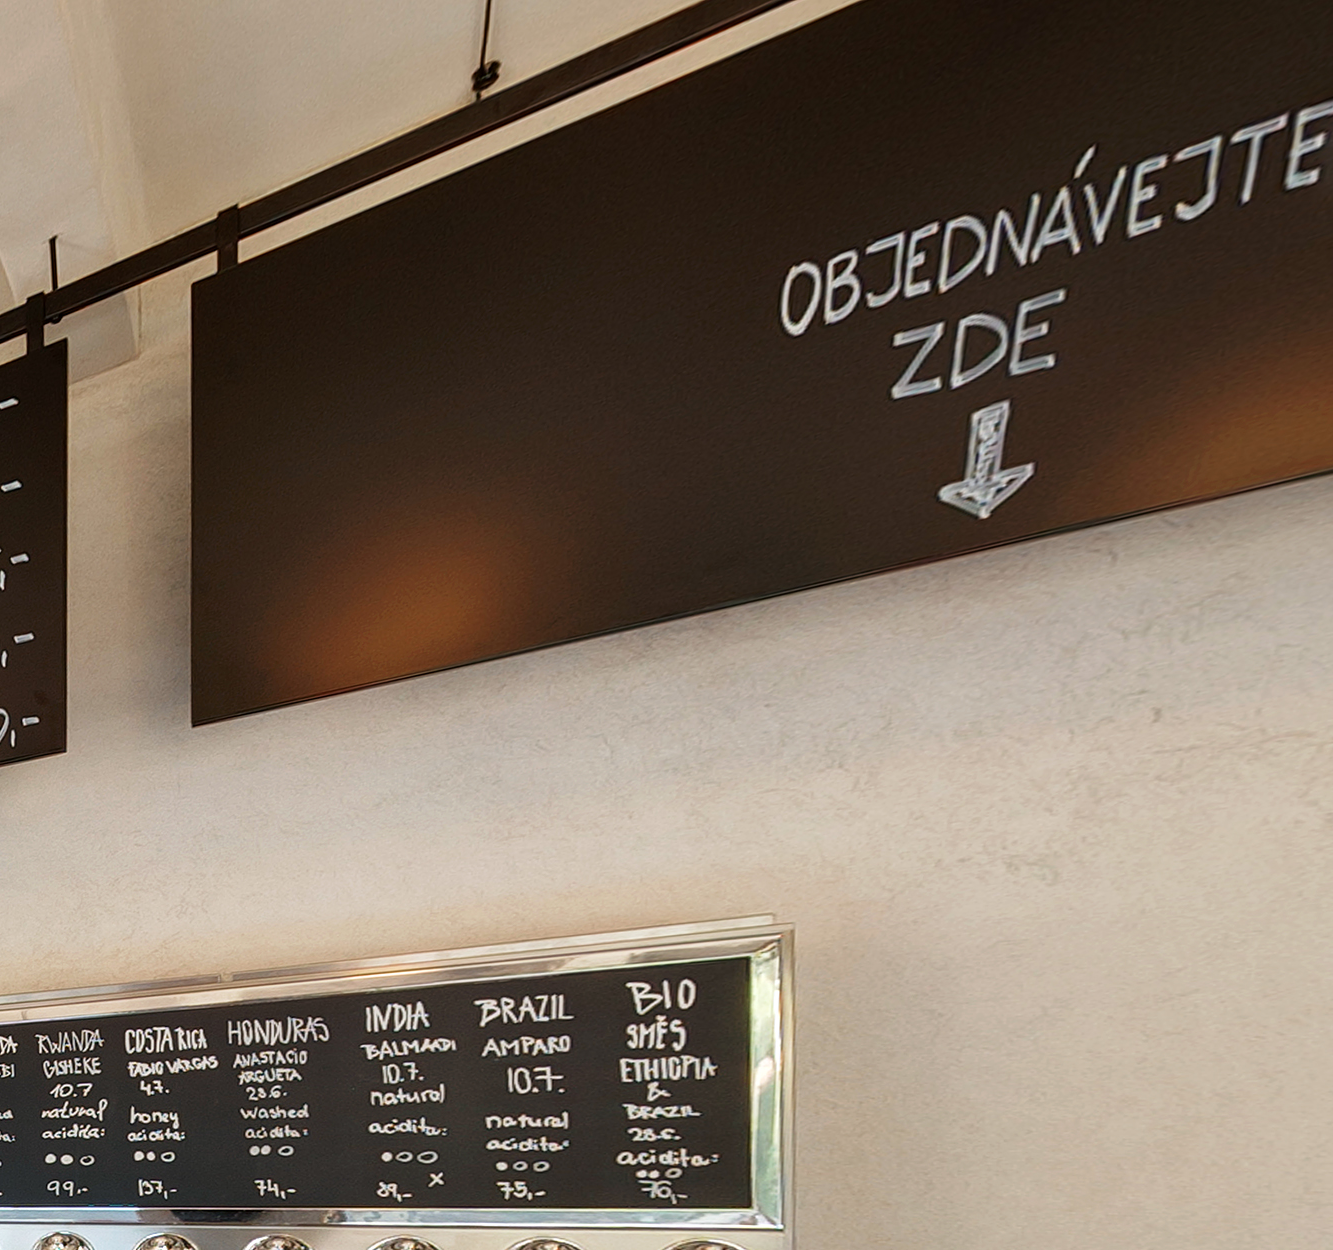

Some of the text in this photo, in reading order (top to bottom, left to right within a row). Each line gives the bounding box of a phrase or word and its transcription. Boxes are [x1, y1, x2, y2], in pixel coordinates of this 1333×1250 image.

[781, 100, 1333, 337] OBJEDNÁVEJTE
[891, 289, 1067, 400] ZDE
[474, 994, 574, 1027] BRAZIL
[625, 979, 697, 1015] BIO
[365, 1001, 430, 1033] INDIA
[34, 1029, 105, 1054] RWANDA
[124, 1026, 208, 1054] COSTA RICA
[227, 1016, 329, 1046] HONDURAS
[481, 1036, 571, 1057] AMPARO
[619, 1056, 718, 1083] ETHIOPIA
[370, 1084, 445, 1105] natural
[130, 1105, 179, 1129] honey
[240, 1103, 309, 1119] washed
[485, 1111, 569, 1129] natural
[622, 1104, 701, 1120] BRAZIL
